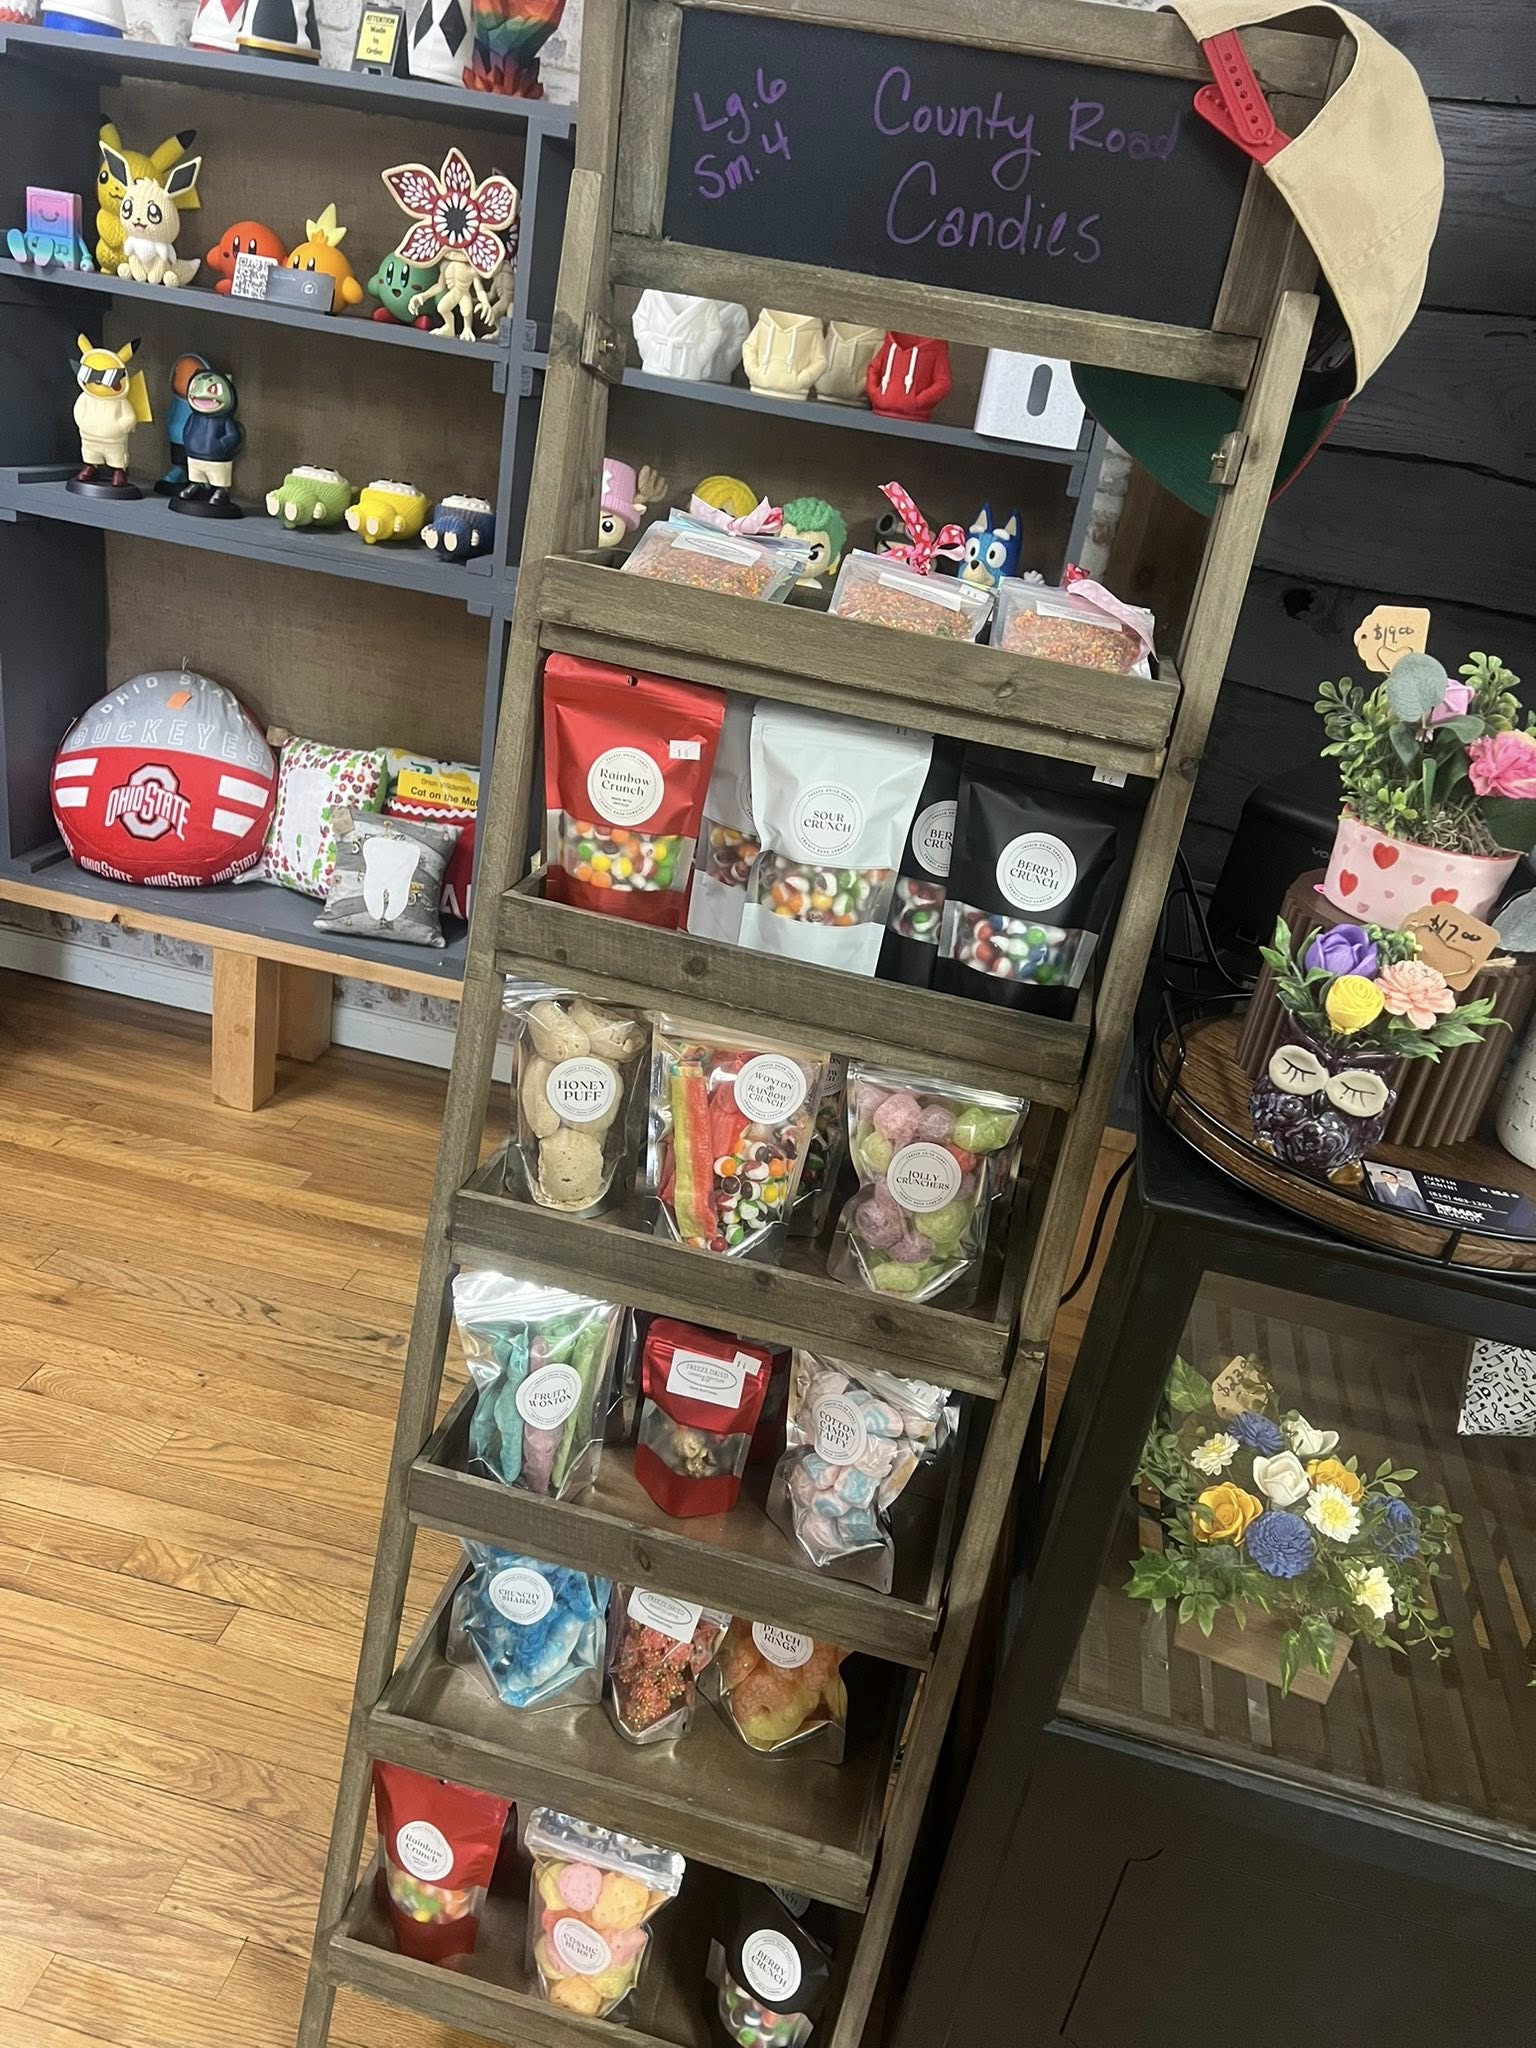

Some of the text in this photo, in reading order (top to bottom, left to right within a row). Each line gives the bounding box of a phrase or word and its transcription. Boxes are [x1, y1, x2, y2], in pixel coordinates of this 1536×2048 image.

[366, 15, 395, 24] ATTENTION
[370, 26, 386, 34] Made
[366, 46, 383, 55] Order
[873, 66, 1181, 191] County Road
[886, 160, 1102, 264] Candies
[100, 676, 158, 714] OHIO
[71, 719, 264, 766] BUCKEYES
[600, 768, 650, 786] Rainbow
[410, 786, 428, 798] Cat
[429, 790, 441, 800] on
[443, 793, 459, 803] the
[601, 780, 644, 797] Crunch
[803, 818, 851, 833] CRUNCH
[813, 810, 845, 823] SOUR
[924, 838, 953, 849] CRUN
[930, 829, 953, 841] BER
[1017, 859, 1058, 878] BERRY
[1010, 867, 1059, 890] CRUNCH
[558, 1080, 607, 1090] HONEY
[755, 1071, 794, 1090] WONTON
[564, 1091, 602, 1101] PUFF
[748, 1084, 790, 1103] RAINBOW
[749, 1092, 784, 1108] CRUNCH
[896, 1176, 950, 1190] CRUNCHERS
[908, 1170, 940, 1182] JOLLY
[1422, 1175, 1457, 1186] JUSTIN
[529, 1395, 571, 1407] WONTON
[534, 1387, 568, 1400] FRUITY
[820, 1411, 856, 1436] COTTON
[820, 1420, 851, 1441] CANDY
[819, 1428, 848, 1448] TAFFY
[498, 1588, 540, 1600] CRUNCHY
[502, 1595, 537, 1605] SHARKS
[764, 1624, 800, 1647] PEACH
[764, 1633, 796, 1653] RINGS
[405, 1833, 442, 1858] Rainbow
[405, 1843, 438, 1863] Crunch
[563, 1933, 598, 1954] COSMIC
[565, 1940, 593, 1960] BURST
[751, 1955, 787, 1988] CRUNCH
[757, 1950, 787, 1976] BERRY
